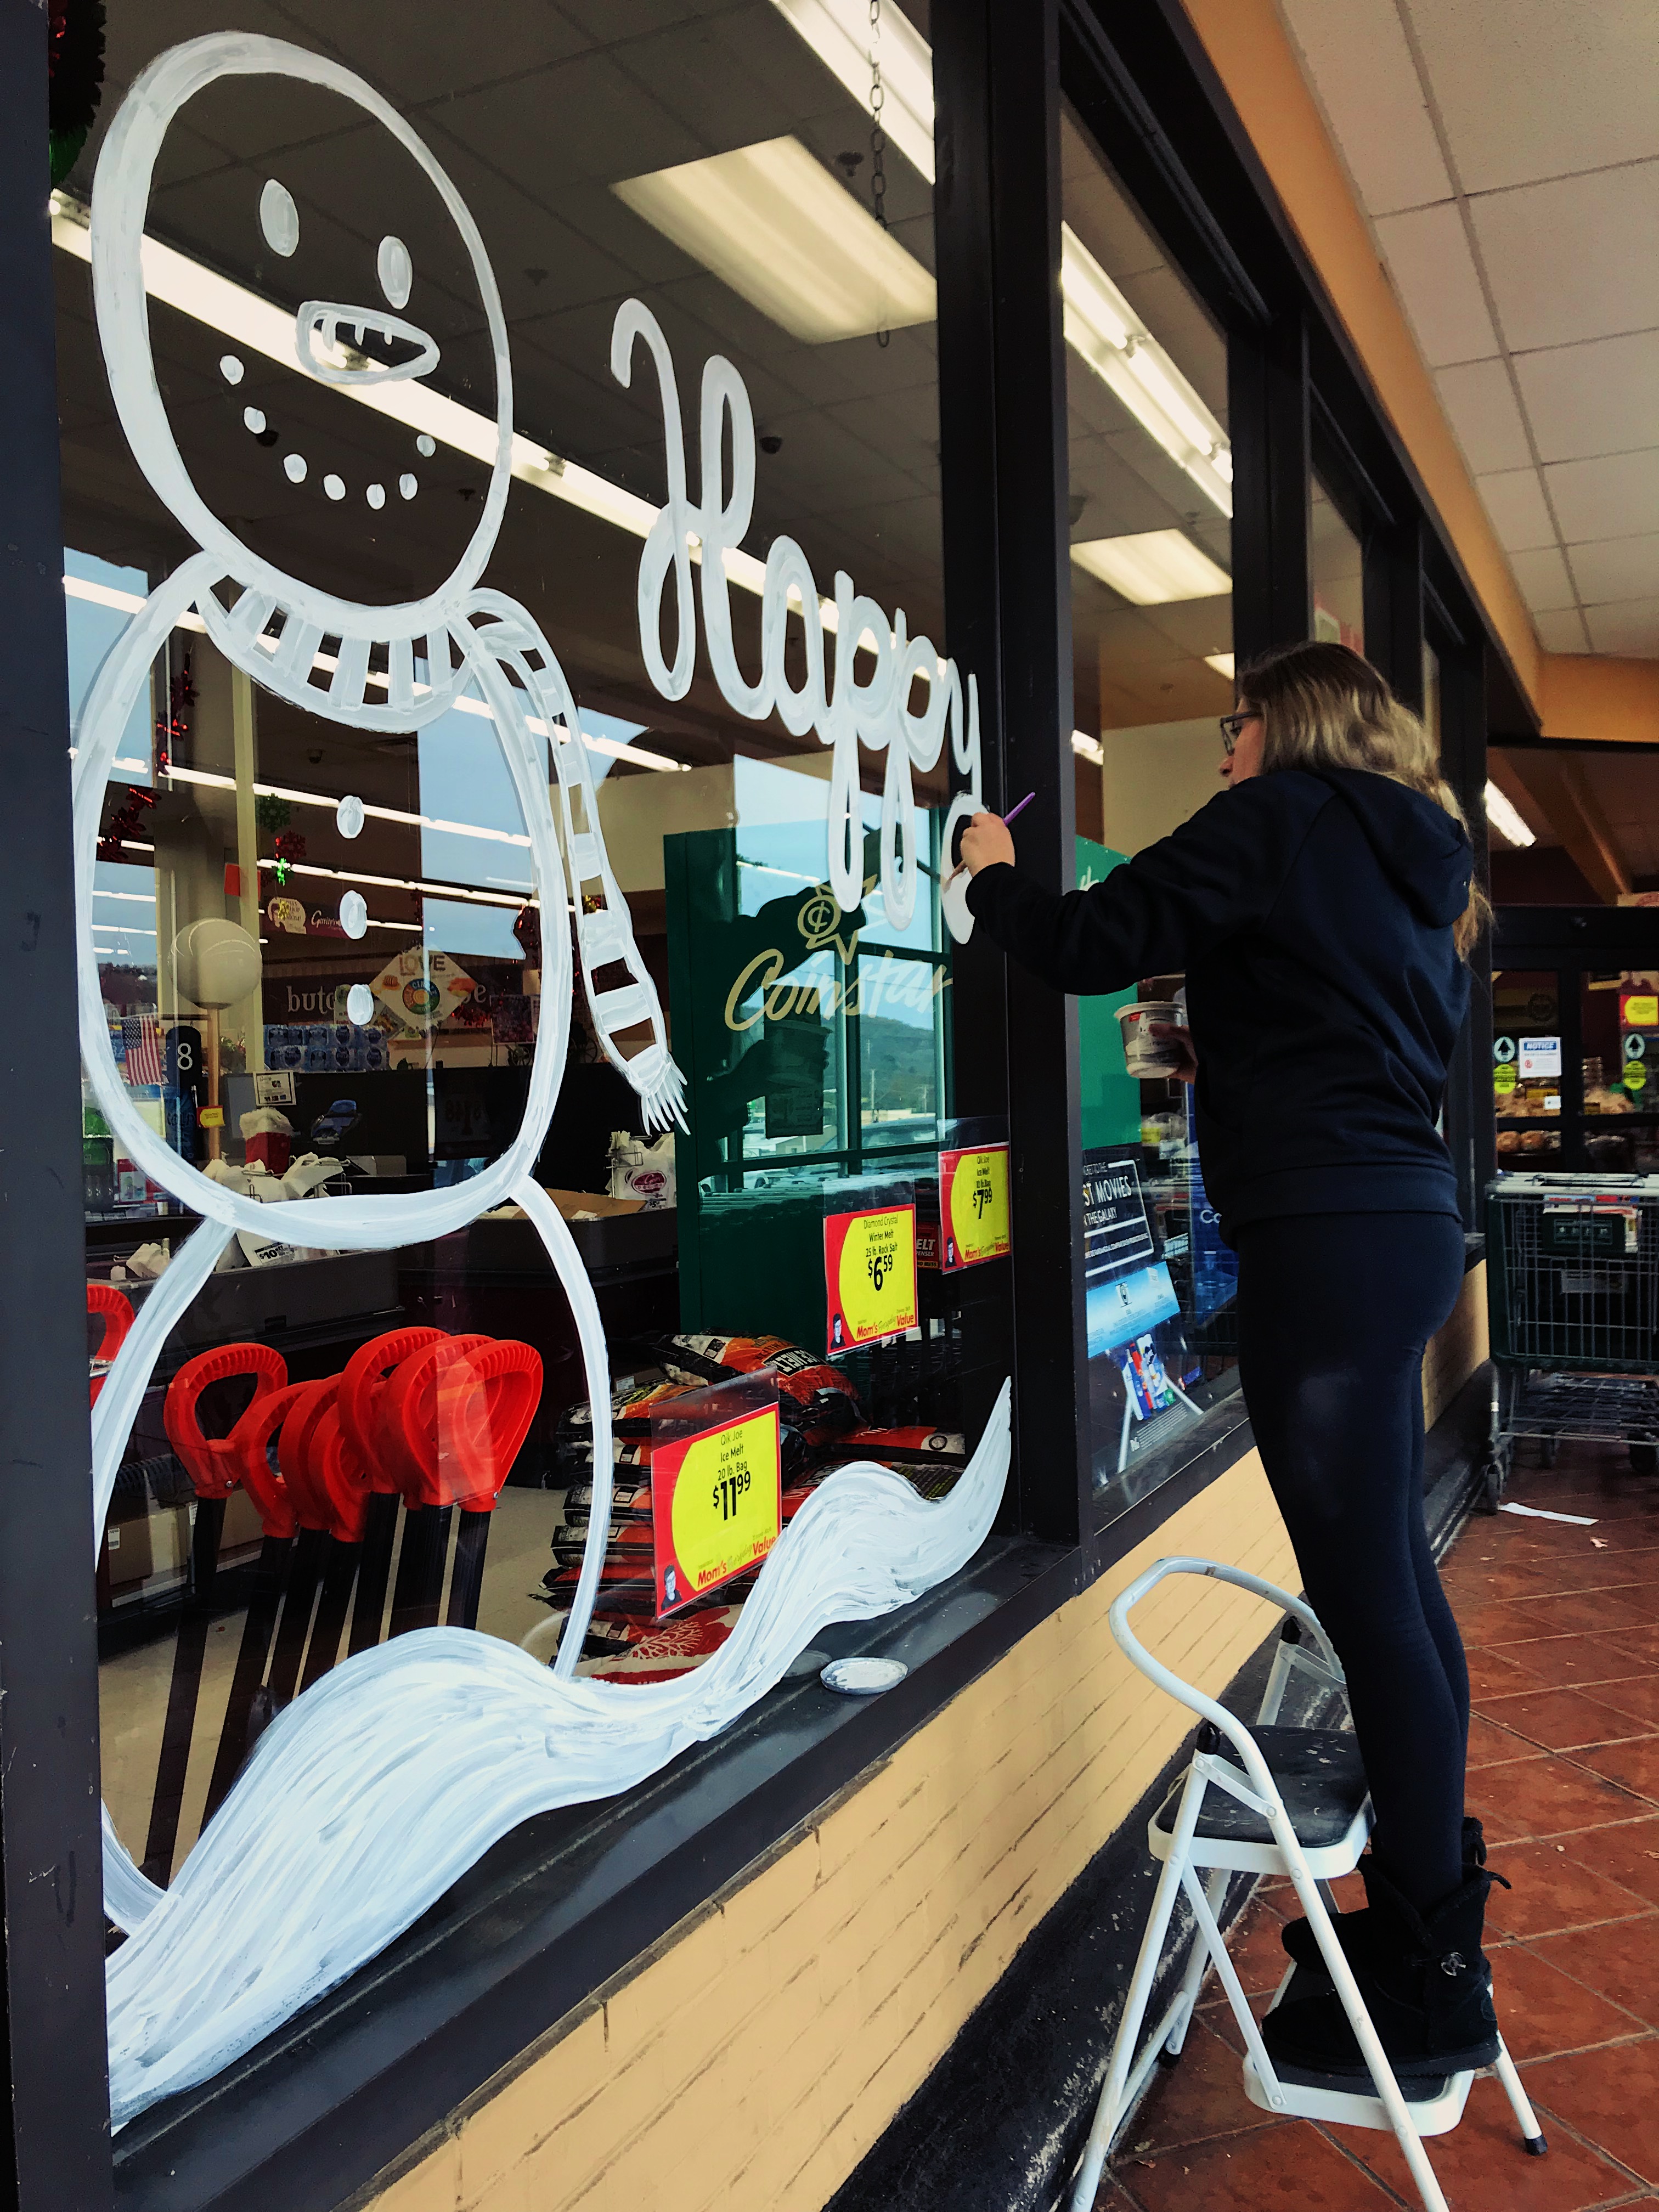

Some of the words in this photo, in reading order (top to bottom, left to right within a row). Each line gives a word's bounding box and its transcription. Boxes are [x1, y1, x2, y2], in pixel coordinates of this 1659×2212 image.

[611, 297, 988, 944] Happy
[724, 947, 953, 1031] Coinstar
[177, 1042, 194, 1070] 8
[1527, 1041, 1554, 1051] NOTICE
[1095, 1175, 1132, 1204] MOVIES
[864, 1216, 883, 1229] Diamond
[884, 1214, 899, 1227] Crystal
[1086, 1210, 1099, 1225] THE
[1099, 1206, 1118, 1223] GALAXY
[869, 1232, 884, 1242] Winter
[884, 1229, 894, 1239] Melt
[866, 1248, 872, 1257] 25
[878, 1244, 889, 1255] Rock
[889, 1242, 898, 1252] Salt
[964, 1247, 981, 1260] Mom's
[994, 1242, 1009, 1252] Value
[856, 1321, 878, 1339] Mom's
[896, 1312, 914, 1327] Value
[771, 1351, 809, 1373] MELT
[720, 1432, 731, 1446] Qik
[732, 1429, 743, 1442] Joe
[720, 1452, 729, 1463] Ice
[730, 1443, 744, 1459] Melt
[718, 1468, 726, 1481] 20
[726, 1465, 735, 1477] lb.
[736, 1460, 748, 1472] Bag
[697, 1560, 727, 1588] Mom's
[752, 1536, 777, 1556] Value
